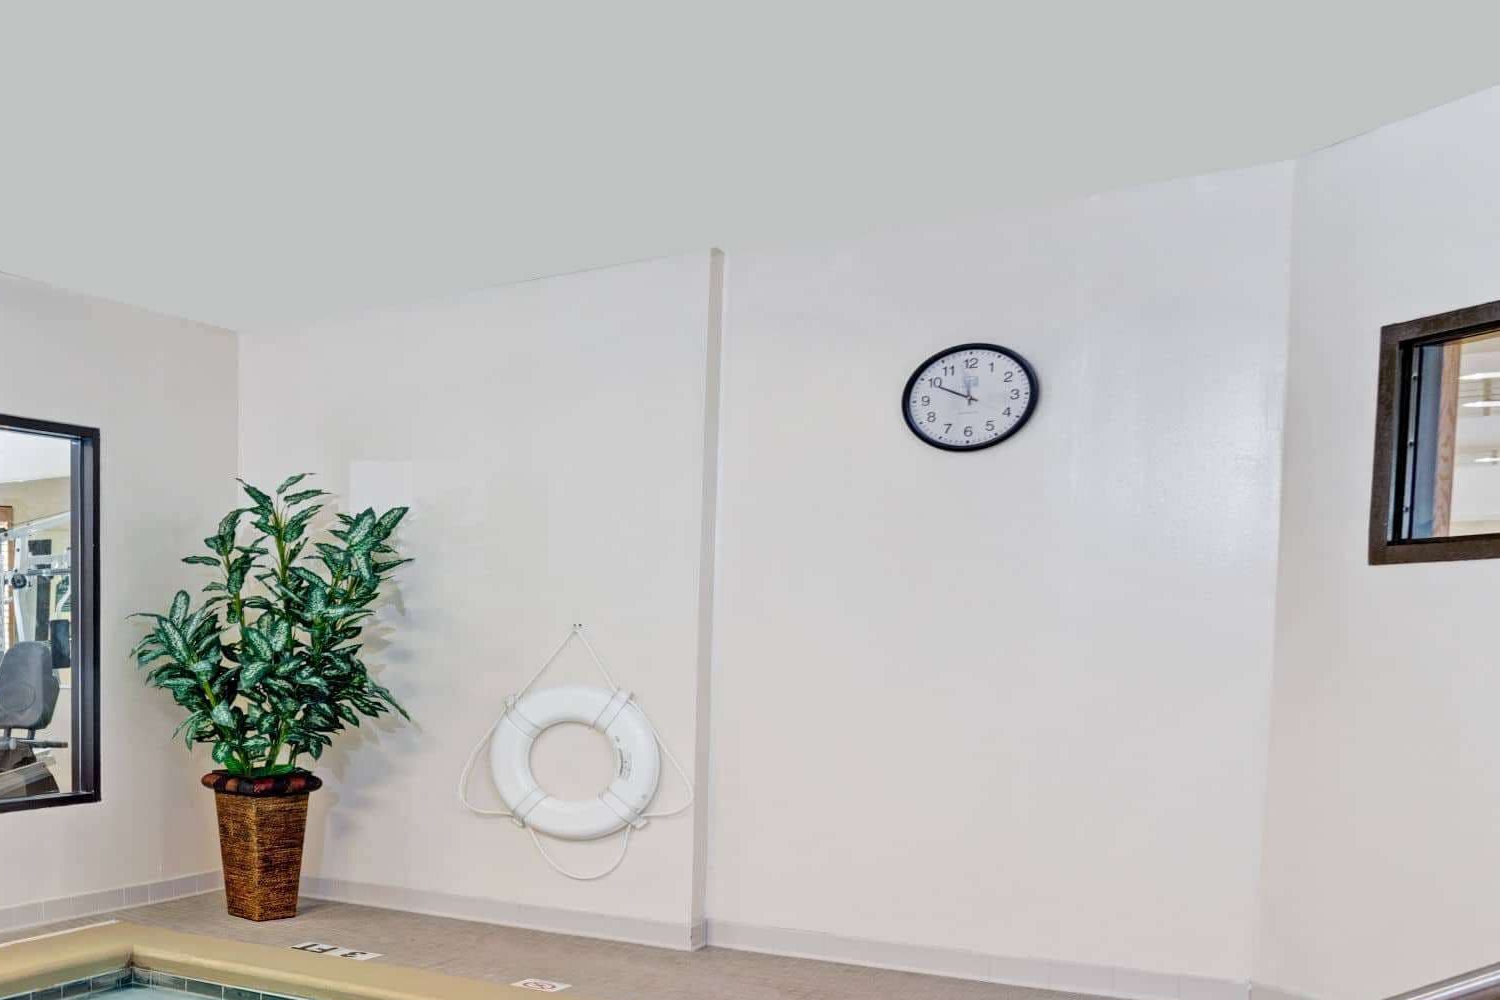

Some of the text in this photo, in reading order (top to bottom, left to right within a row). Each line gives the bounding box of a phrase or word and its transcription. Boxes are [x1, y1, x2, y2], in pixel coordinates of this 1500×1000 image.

[964, 357, 979, 369] 12
[989, 362, 995, 373] 1
[943, 365, 955, 377] 11
[1003, 371, 1014, 383] 2
[928, 376, 943, 389] 10
[1010, 388, 1021, 400] 3
[921, 396, 931, 407] 9
[926, 411, 937, 423] 8
[1002, 407, 1012, 418] 4
[943, 423, 953, 434] 7
[963, 426, 973, 438] 6
[985, 420, 996, 432] 5
